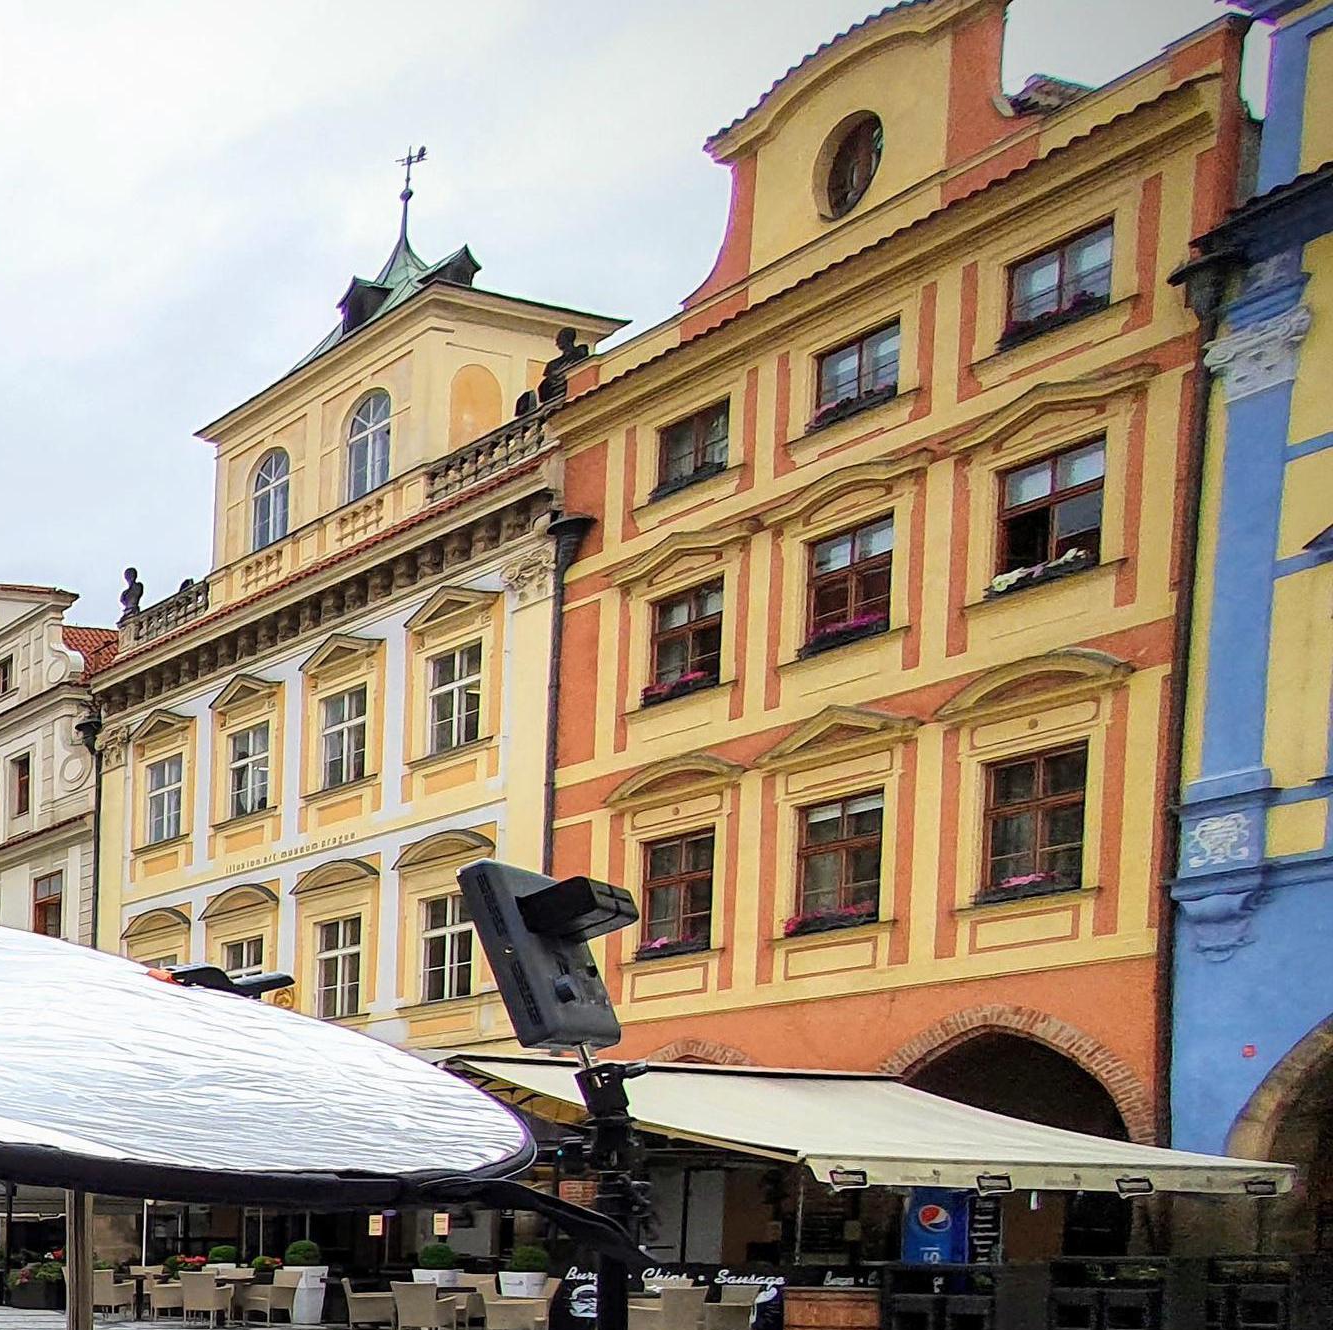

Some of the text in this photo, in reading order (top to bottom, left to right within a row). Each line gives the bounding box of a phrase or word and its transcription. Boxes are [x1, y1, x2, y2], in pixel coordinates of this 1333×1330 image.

[225, 859, 261, 874] illusion
[280, 843, 319, 859] museum
[321, 832, 356, 848] prague
[713, 1269, 786, 1291] Sausage
